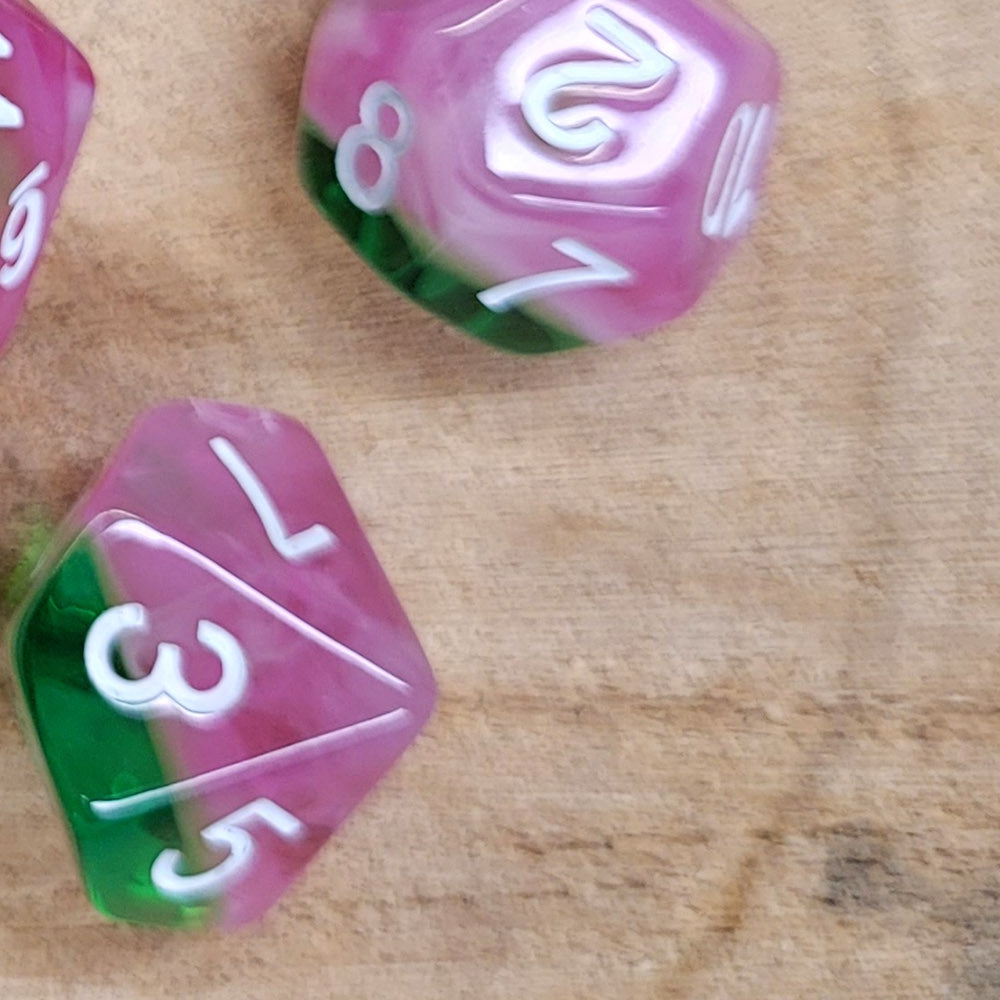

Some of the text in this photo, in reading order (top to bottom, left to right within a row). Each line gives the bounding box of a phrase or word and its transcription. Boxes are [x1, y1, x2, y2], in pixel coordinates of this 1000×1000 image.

[521, 4, 678, 153] 2
[334, 80, 413, 215] 8
[209, 436, 340, 562] 7
[84, 602, 248, 728] 3
[151, 797, 305, 901] 5
